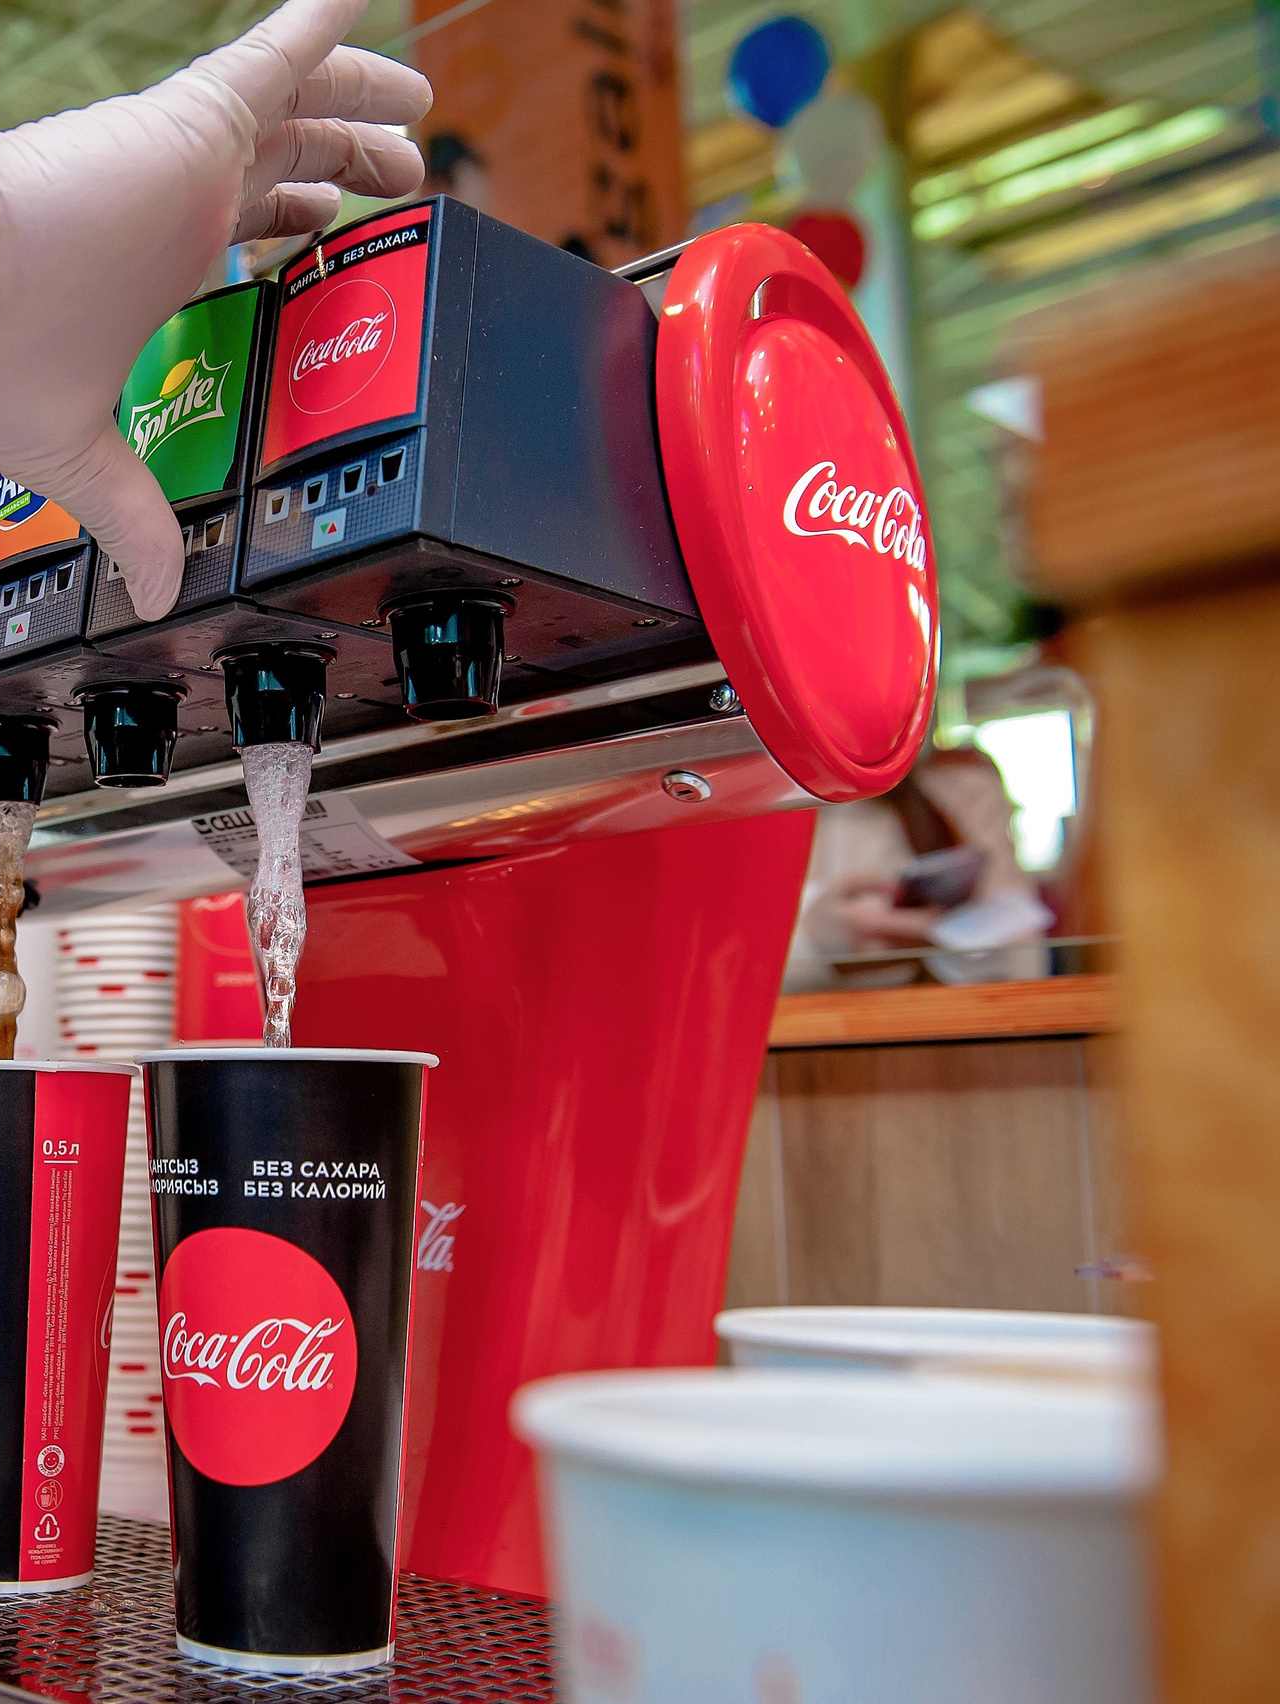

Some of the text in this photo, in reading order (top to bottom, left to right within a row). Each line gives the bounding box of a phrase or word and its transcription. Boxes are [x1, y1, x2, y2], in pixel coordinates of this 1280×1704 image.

[342, 246, 365, 265] БЕЗ
[367, 228, 418, 254] САХАРА
[293, 310, 390, 381] Coca-Cola
[133, 370, 215, 459] Sprite
[783, 461, 927, 571] Coca-Cola
[244, 1180, 284, 1198] БЕЗ
[291, 1180, 386, 1200] КАЛОРИЙ
[252, 1160, 293, 1178] БЕЗ
[299, 1161, 381, 1179] САХАРА
[163, 1311, 345, 1392] Coca-Cola
